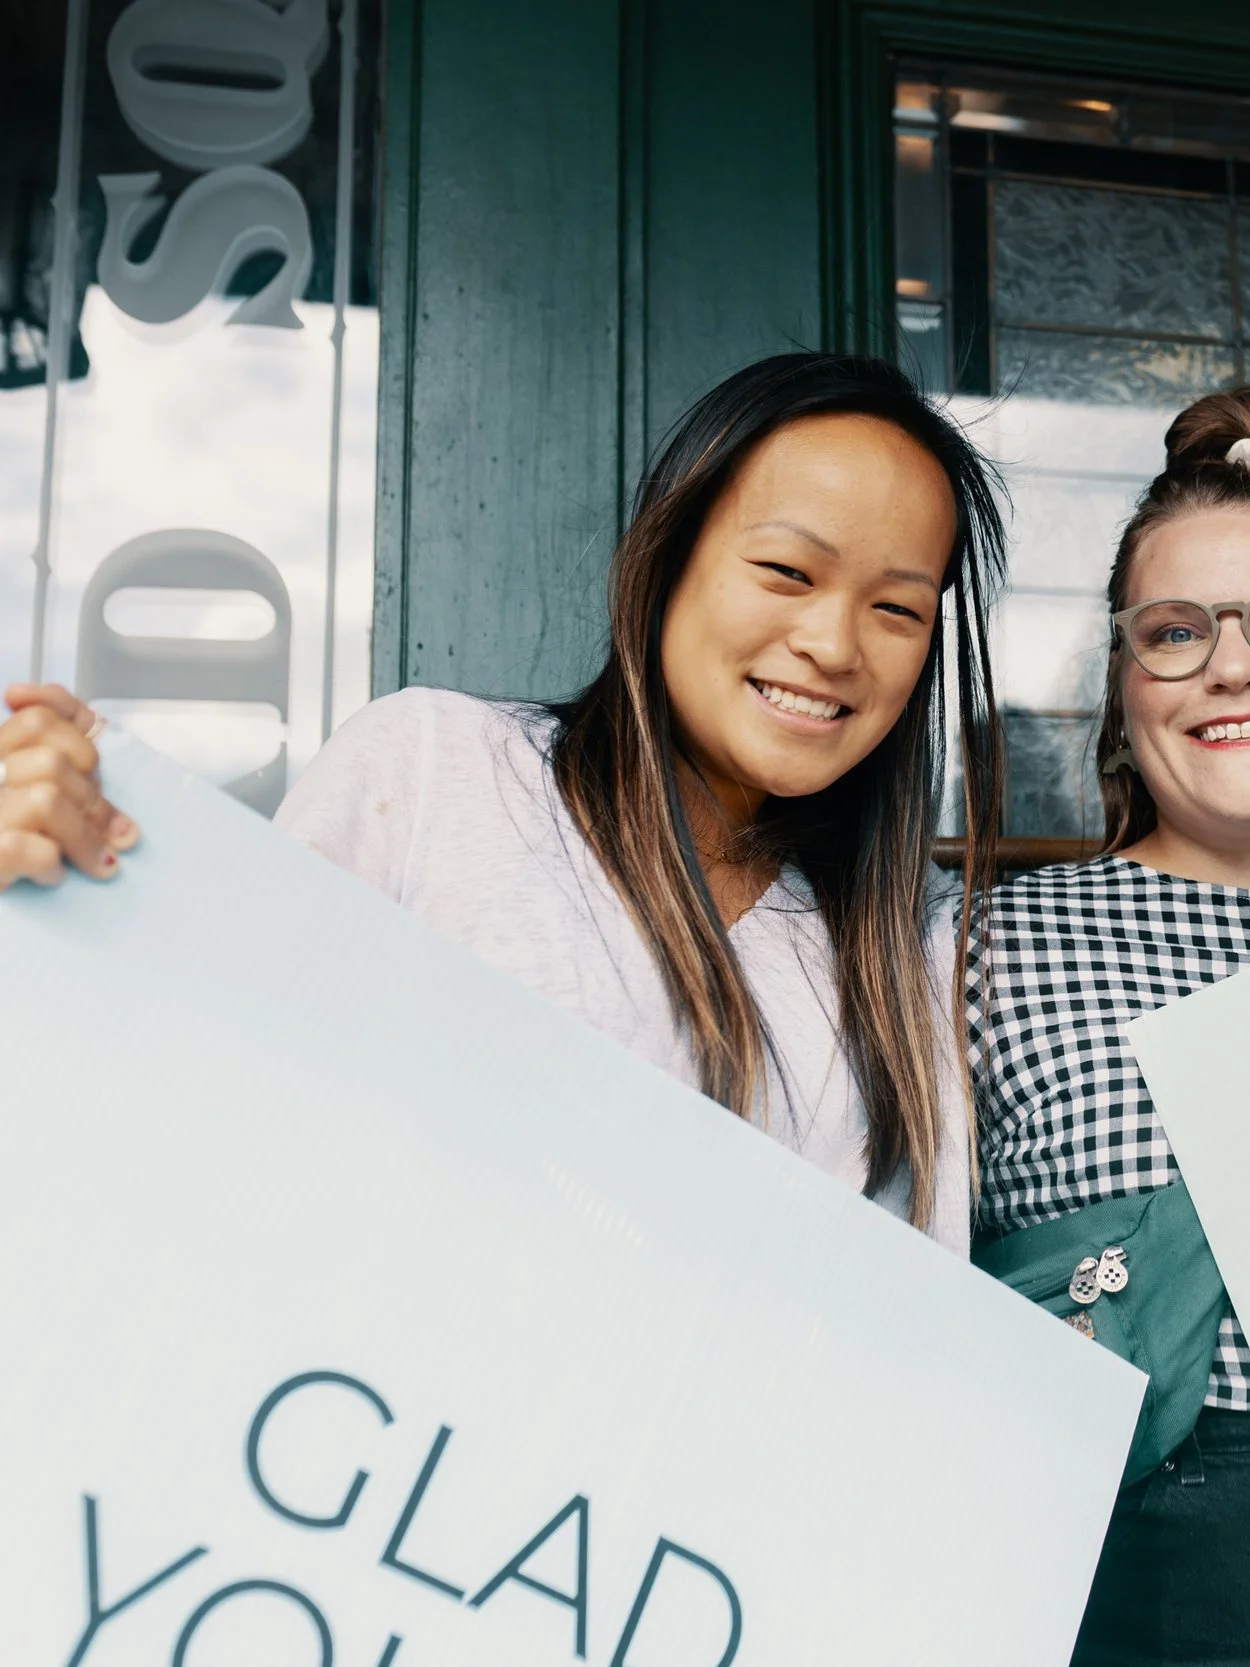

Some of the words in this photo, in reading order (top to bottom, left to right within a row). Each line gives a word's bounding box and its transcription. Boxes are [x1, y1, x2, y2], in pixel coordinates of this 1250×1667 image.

[97, 0, 329, 330] SQ
[75, 528, 292, 820] D
[66, 1494, 402, 1667] YO
[245, 1370, 744, 1667] GLAD
